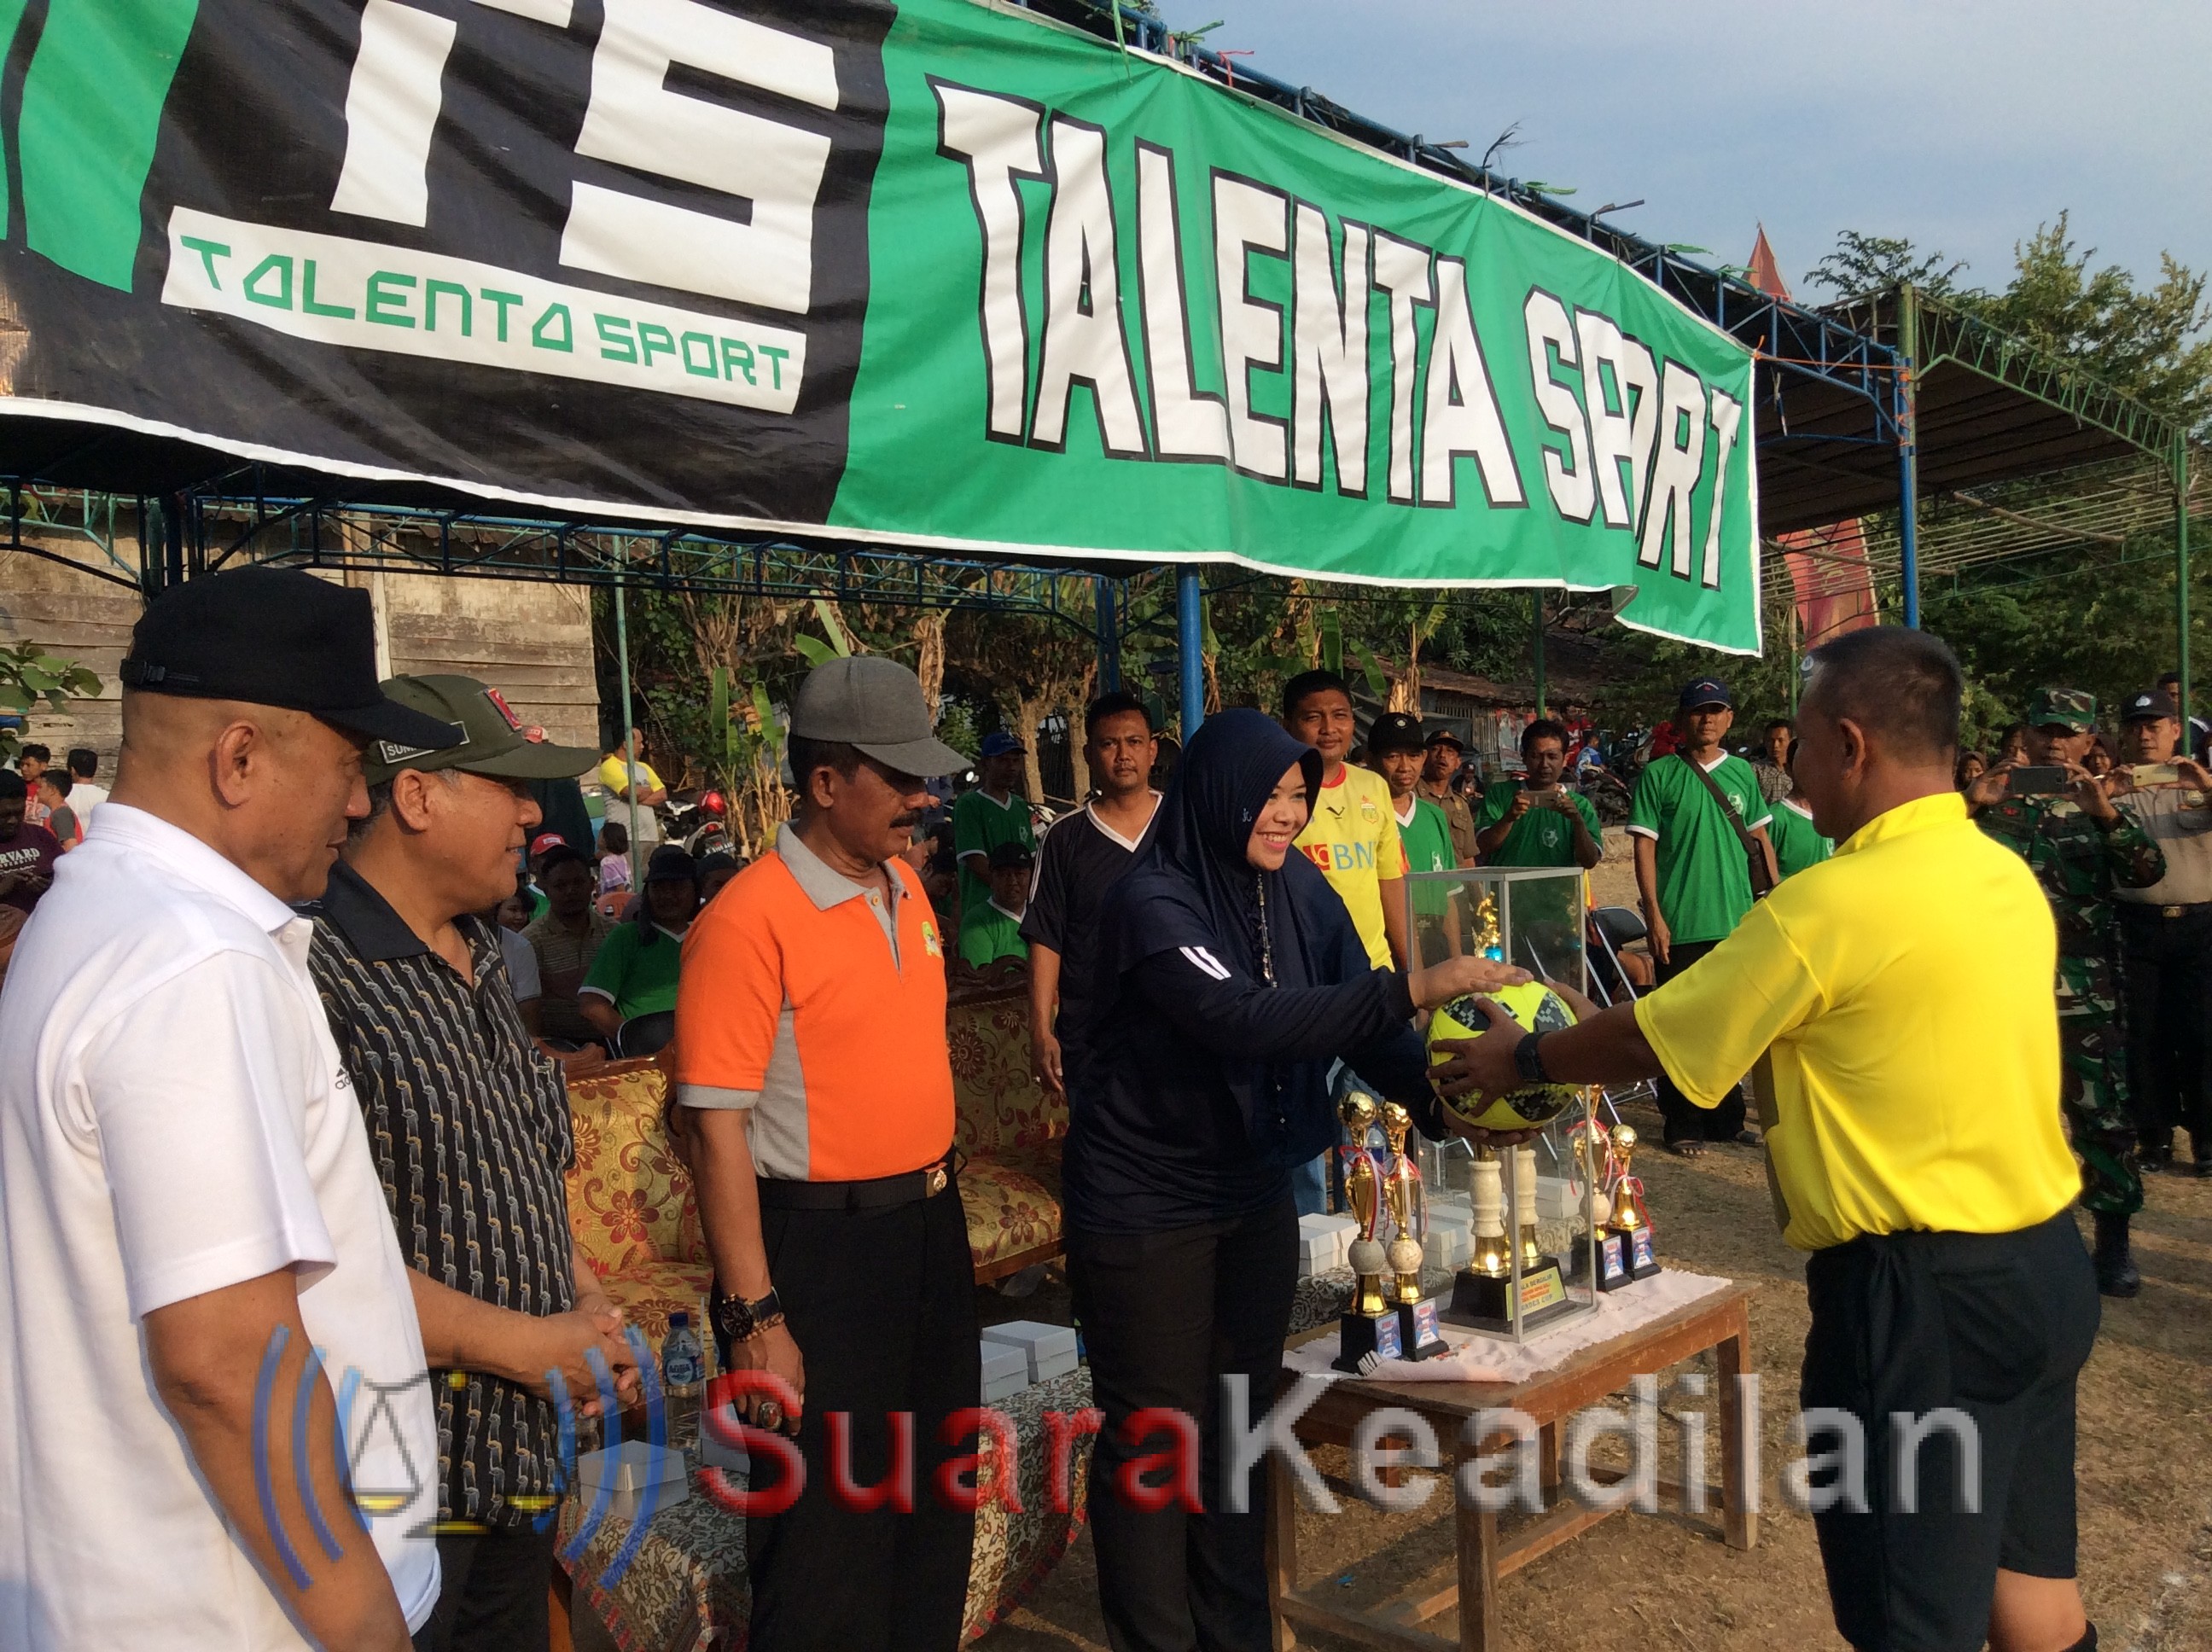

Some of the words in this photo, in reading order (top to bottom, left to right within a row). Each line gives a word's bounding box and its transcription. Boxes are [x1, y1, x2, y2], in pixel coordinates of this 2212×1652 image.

[182, 236, 573, 352] TALENTA
[595, 314, 789, 388] SPORT
[925, 73, 1528, 509] TALENTA
[1333, 841, 1376, 870] BN
